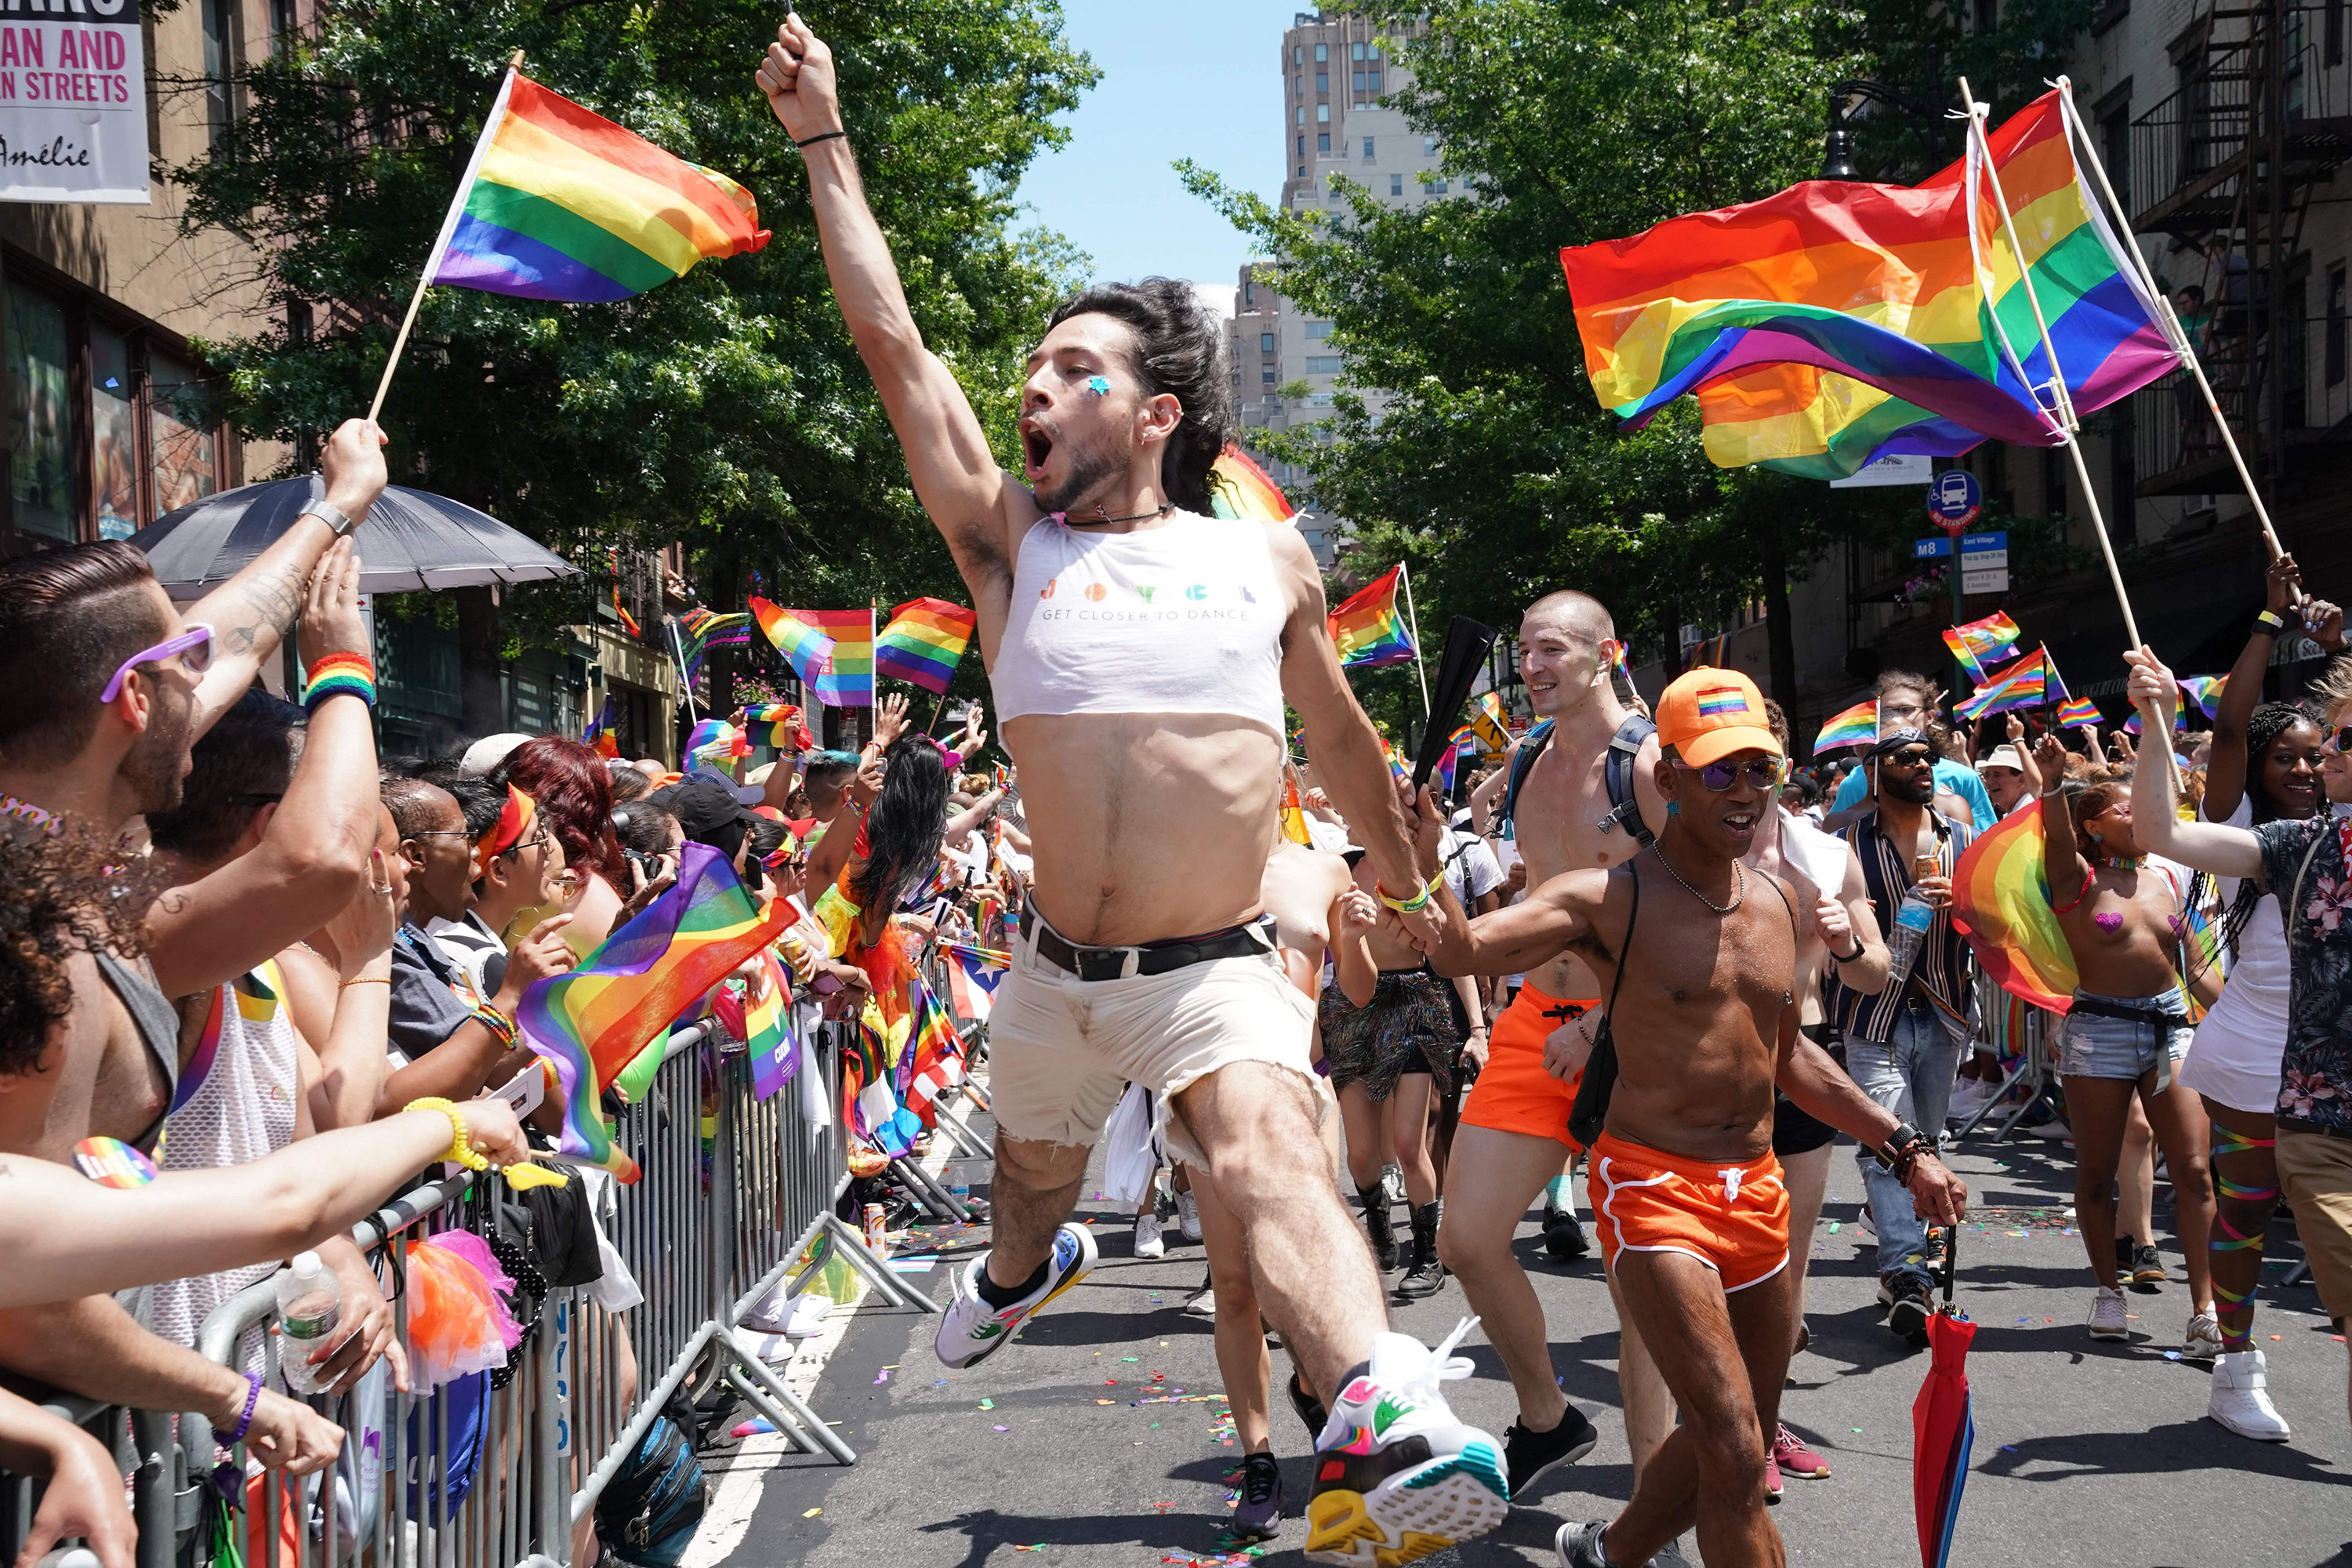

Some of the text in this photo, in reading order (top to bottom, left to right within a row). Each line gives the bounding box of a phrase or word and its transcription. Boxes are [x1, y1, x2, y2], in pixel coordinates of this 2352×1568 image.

[59, 29, 125, 71] AND
[25, 72, 129, 103] STREETS
[1932, 508, 1976, 527] NO STANDING
[1918, 542, 1936, 555] M8
[1043, 609, 1248, 621] GET CLOSER TO DANCE
